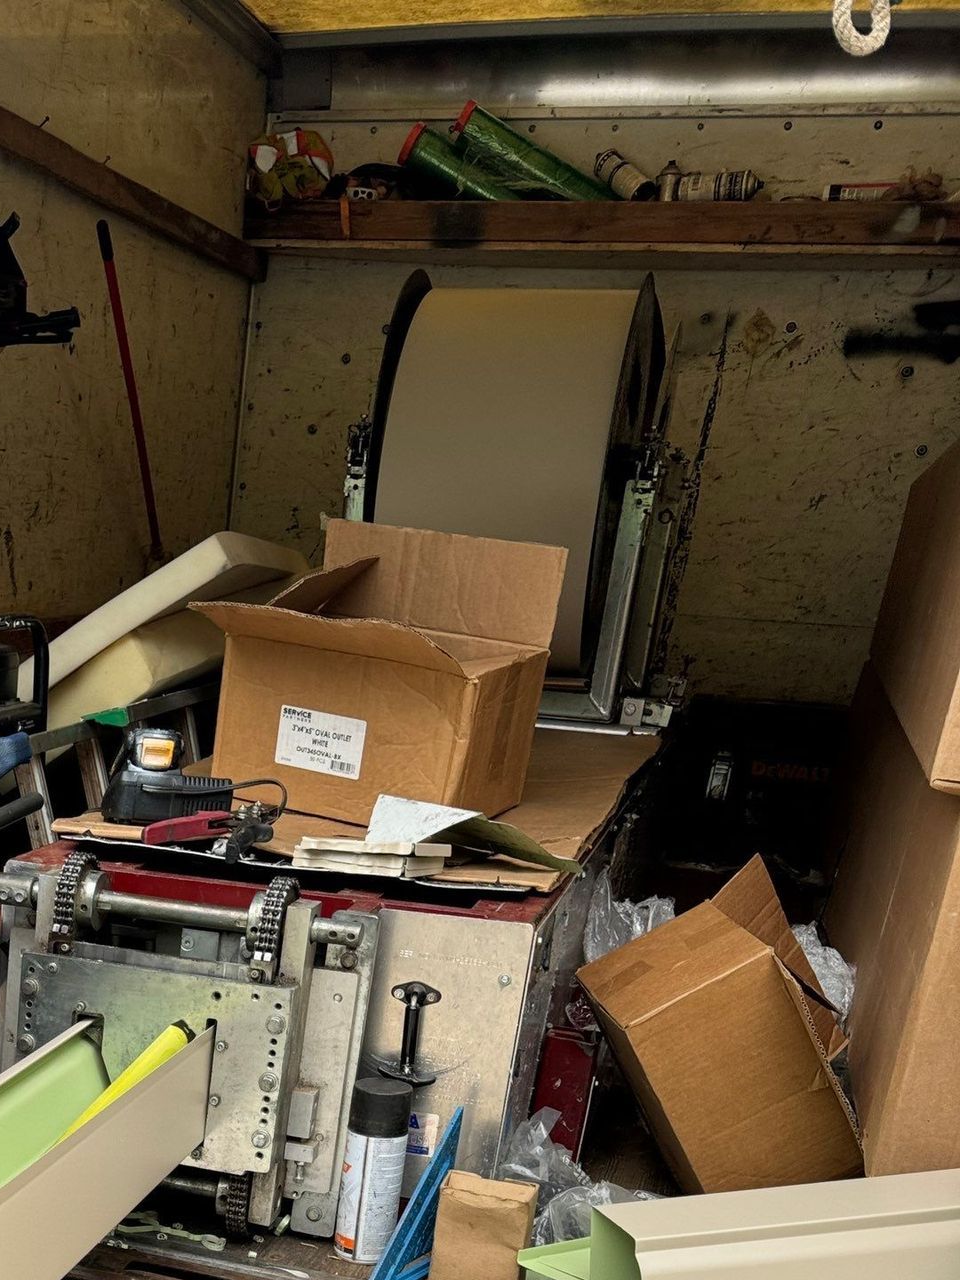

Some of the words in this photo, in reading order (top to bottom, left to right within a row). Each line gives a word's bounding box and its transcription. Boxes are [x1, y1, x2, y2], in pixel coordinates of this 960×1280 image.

[315, 729, 331, 739] OVAL
[332, 732, 352, 742] OUTLET
[312, 739, 328, 748] WHITE
